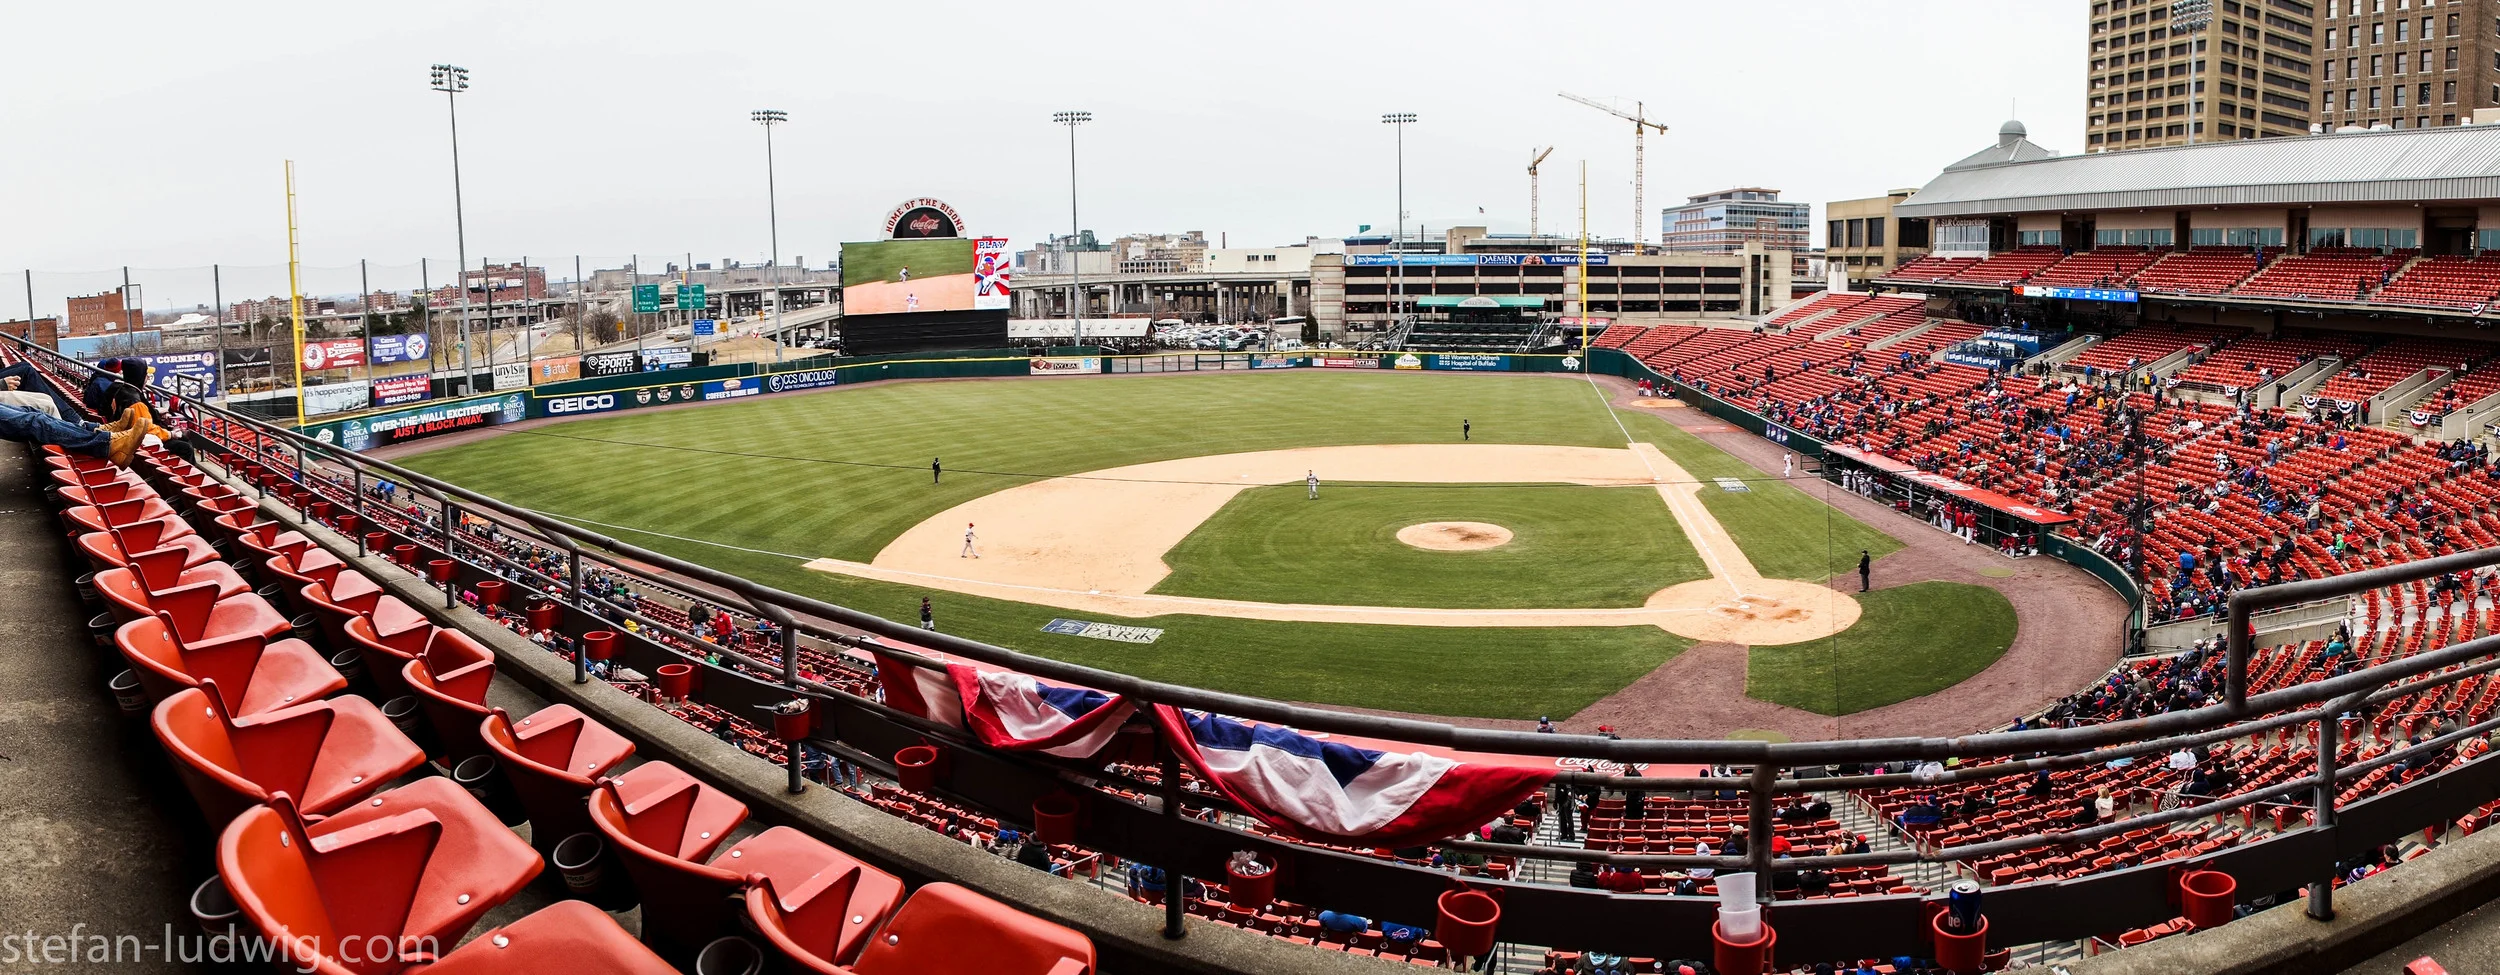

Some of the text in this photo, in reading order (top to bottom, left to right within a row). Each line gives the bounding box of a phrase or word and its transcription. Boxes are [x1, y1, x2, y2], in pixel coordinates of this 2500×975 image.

[886, 198, 965, 233] HOME OF THE BISONS
[910, 218, 940, 230] Coca-Cola
[979, 241, 1004, 249] PLAY
[1480, 255, 1517, 264] DAEMEN
[157, 354, 202, 364] CORNER
[598, 357, 633, 368] SPORTS
[495, 364, 518, 378] unyts
[553, 363, 569, 374] at&t
[784, 370, 836, 384] CCS ONCOLOGY
[304, 389, 314, 397] It's
[315, 387, 352, 397] happening
[503, 401, 524, 409] SENECA
[549, 394, 614, 412] GEICO
[371, 402, 501, 433] OVER-THE-WALL EXCITEMENT.
[393, 414, 483, 438] JUST A BLOCK AWAY.
[319, 432, 331, 442] 325
[343, 428, 368, 439] SENECA
[1085, 628, 1152, 640] PARK
[1555, 757, 1649, 778] Coca-Coa
